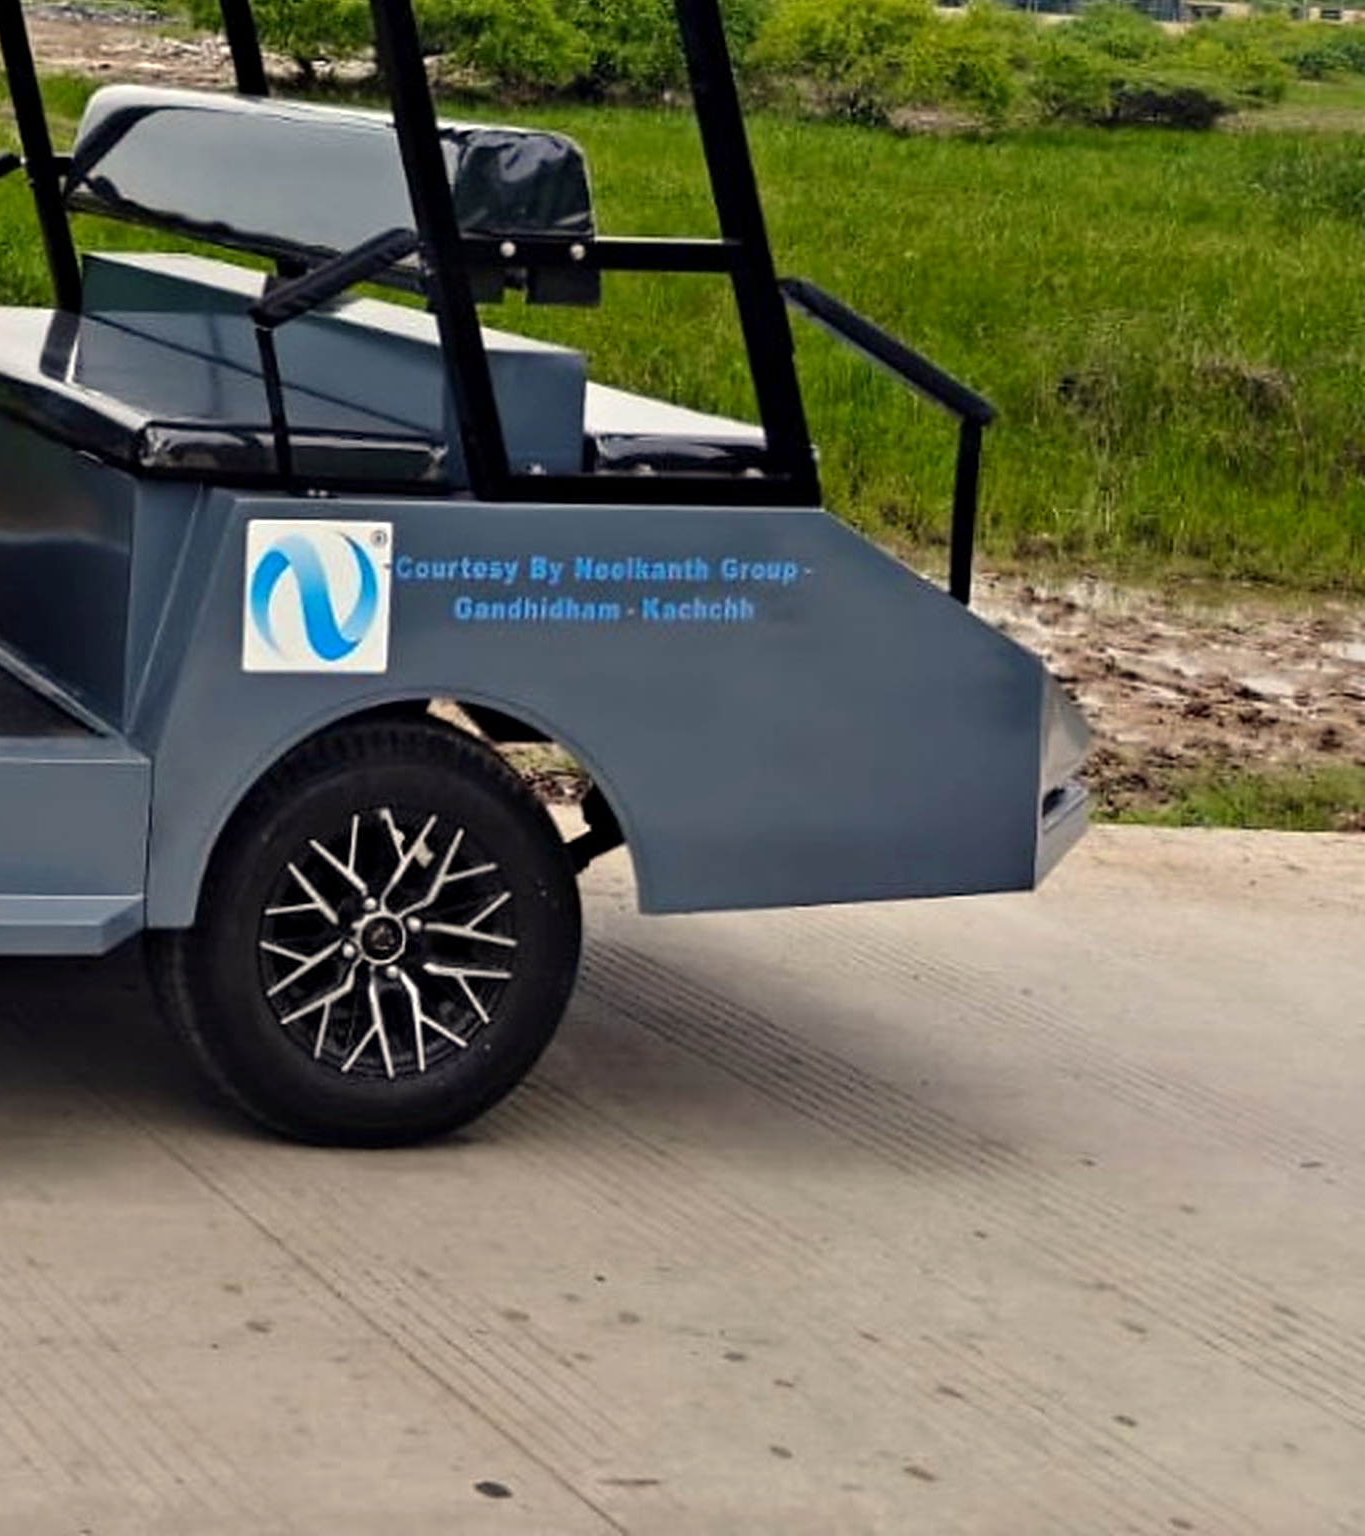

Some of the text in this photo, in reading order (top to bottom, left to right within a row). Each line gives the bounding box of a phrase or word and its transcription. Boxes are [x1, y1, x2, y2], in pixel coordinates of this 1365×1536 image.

[396, 556, 518, 584] Courtesy
[530, 556, 563, 584] By
[721, 558, 798, 585] Group
[453, 596, 620, 620] Gandhidham
